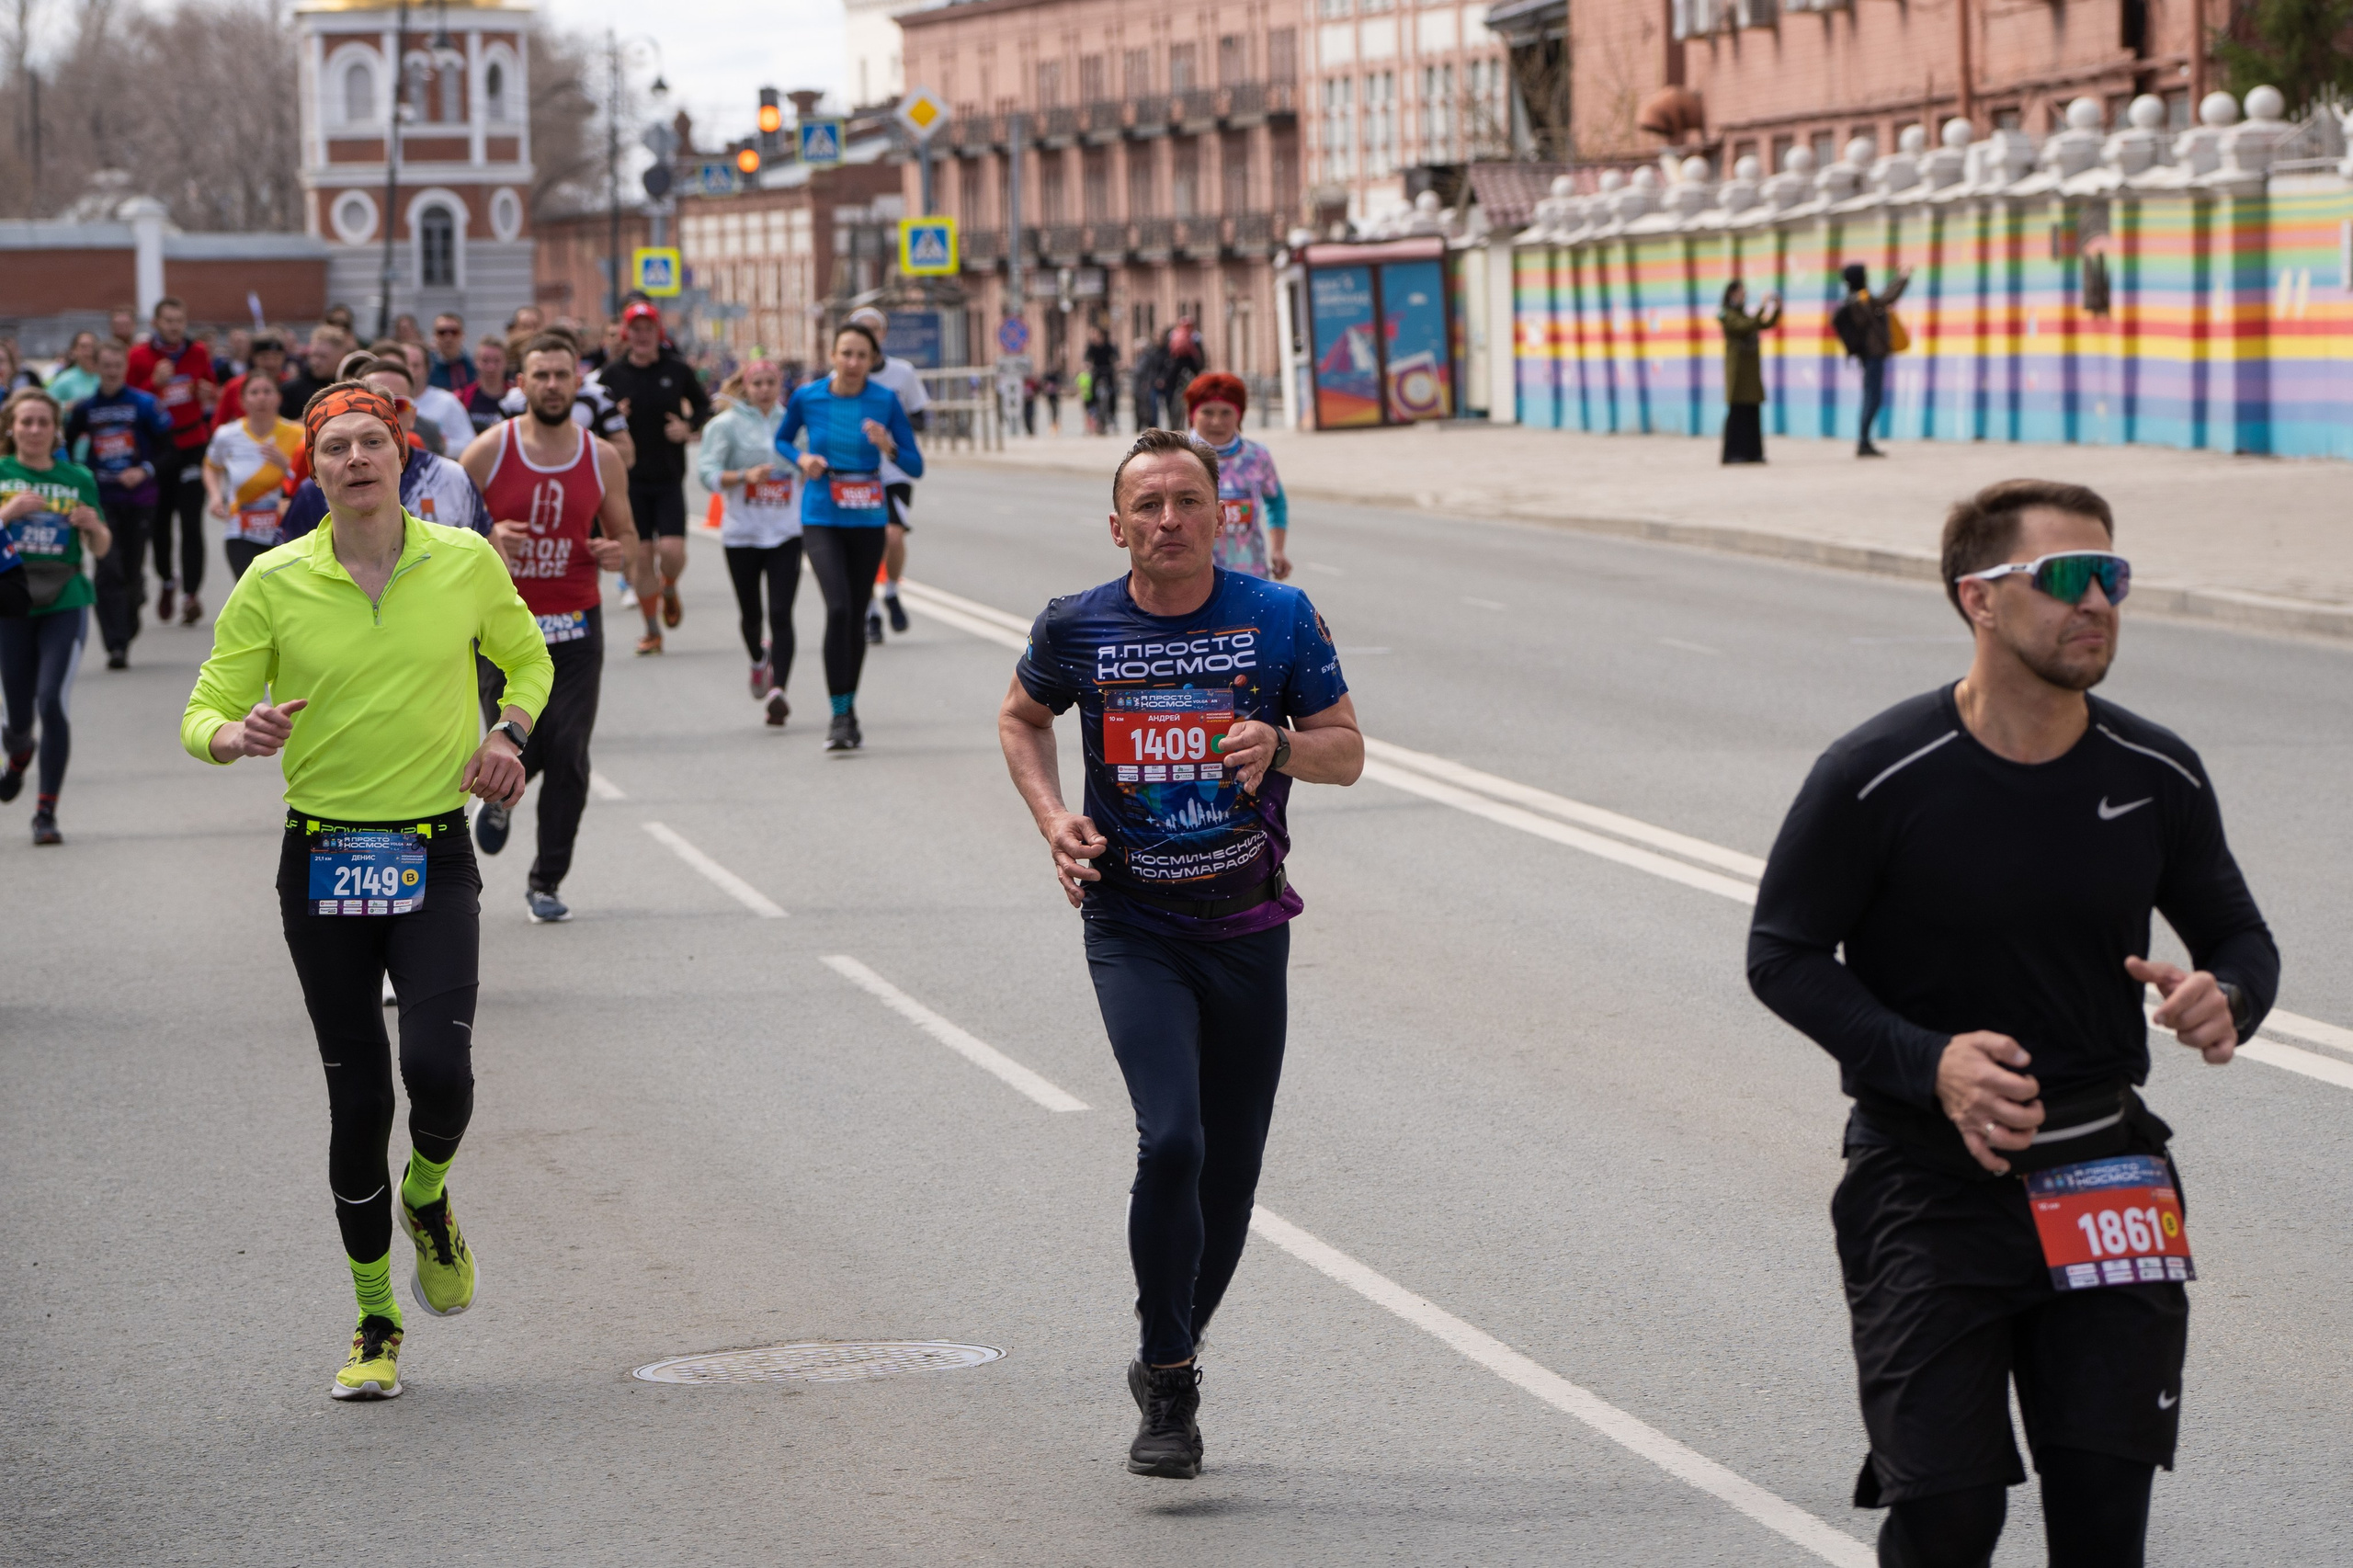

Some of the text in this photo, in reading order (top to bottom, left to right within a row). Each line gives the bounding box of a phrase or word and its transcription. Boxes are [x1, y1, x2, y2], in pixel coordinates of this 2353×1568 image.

[518, 537, 573, 560] RON
[1097, 633, 1255, 660] Я ПРОСТО
[1097, 650, 1257, 680] КОСМОС
[1130, 726, 1207, 761] 1409
[1131, 840, 1266, 879] ПОЛУМАРАФОН
[333, 866, 399, 897] 2149
[2075, 1171, 2143, 1187] КОСМОС
[2077, 1206, 2166, 1257] 1861
